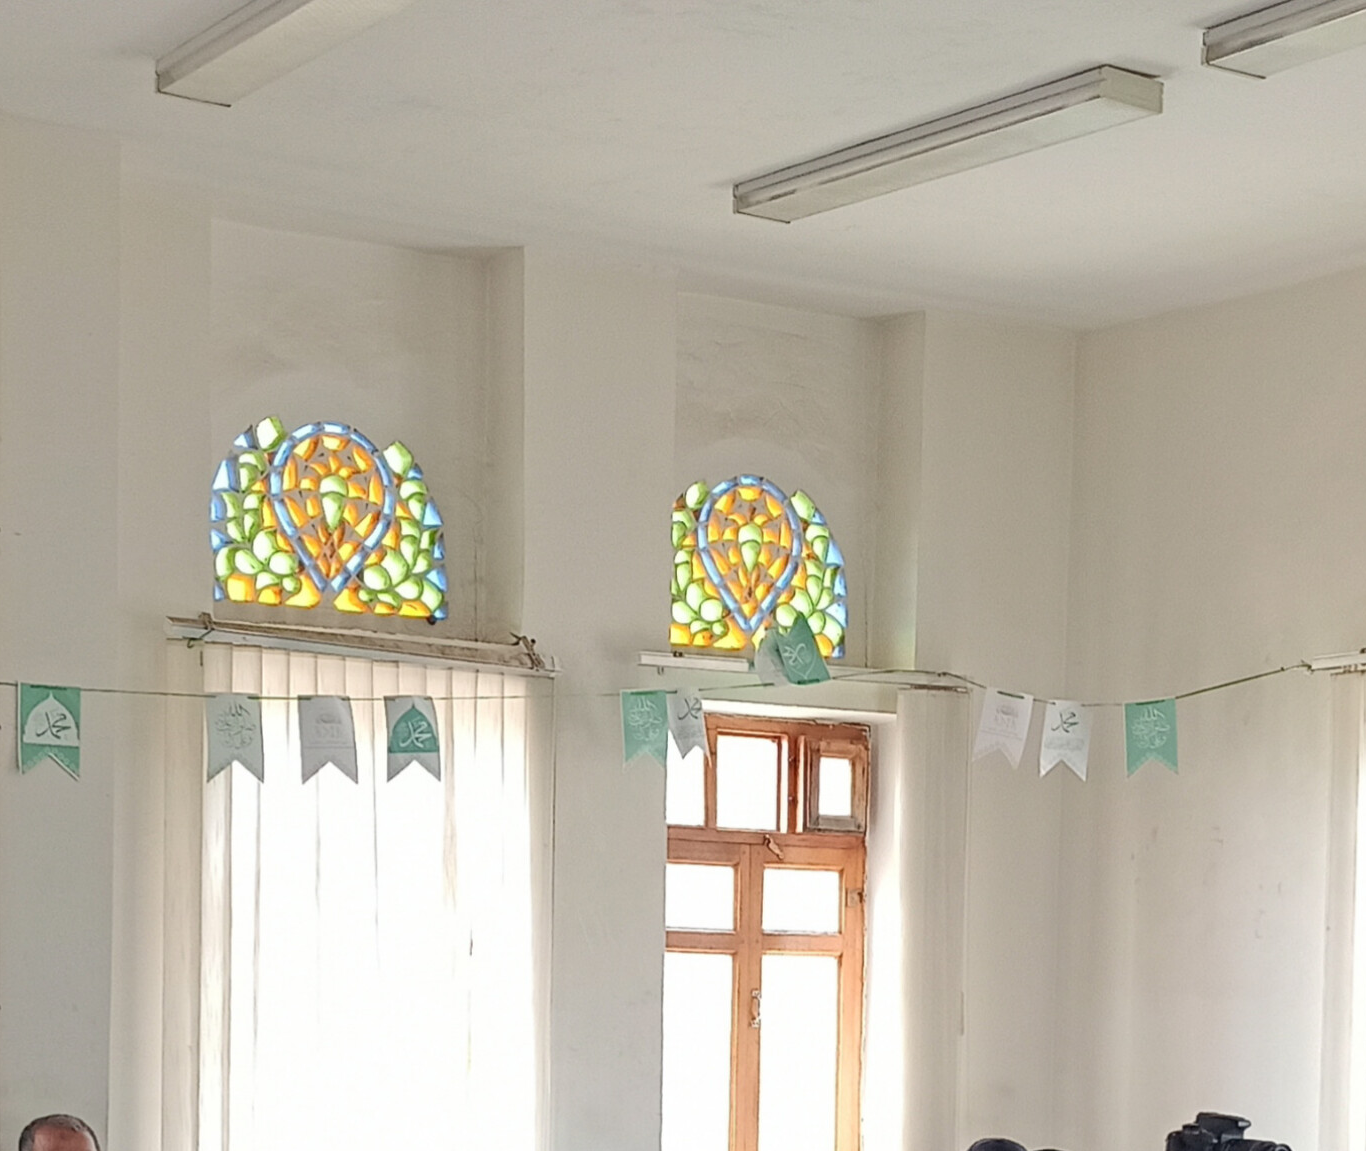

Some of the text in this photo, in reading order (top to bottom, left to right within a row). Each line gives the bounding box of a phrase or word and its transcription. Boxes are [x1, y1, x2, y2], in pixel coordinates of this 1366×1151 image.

[35, 711, 72, 740] محمد
[399, 721, 433, 748] محمد
[1051, 711, 1080, 733] محمد
